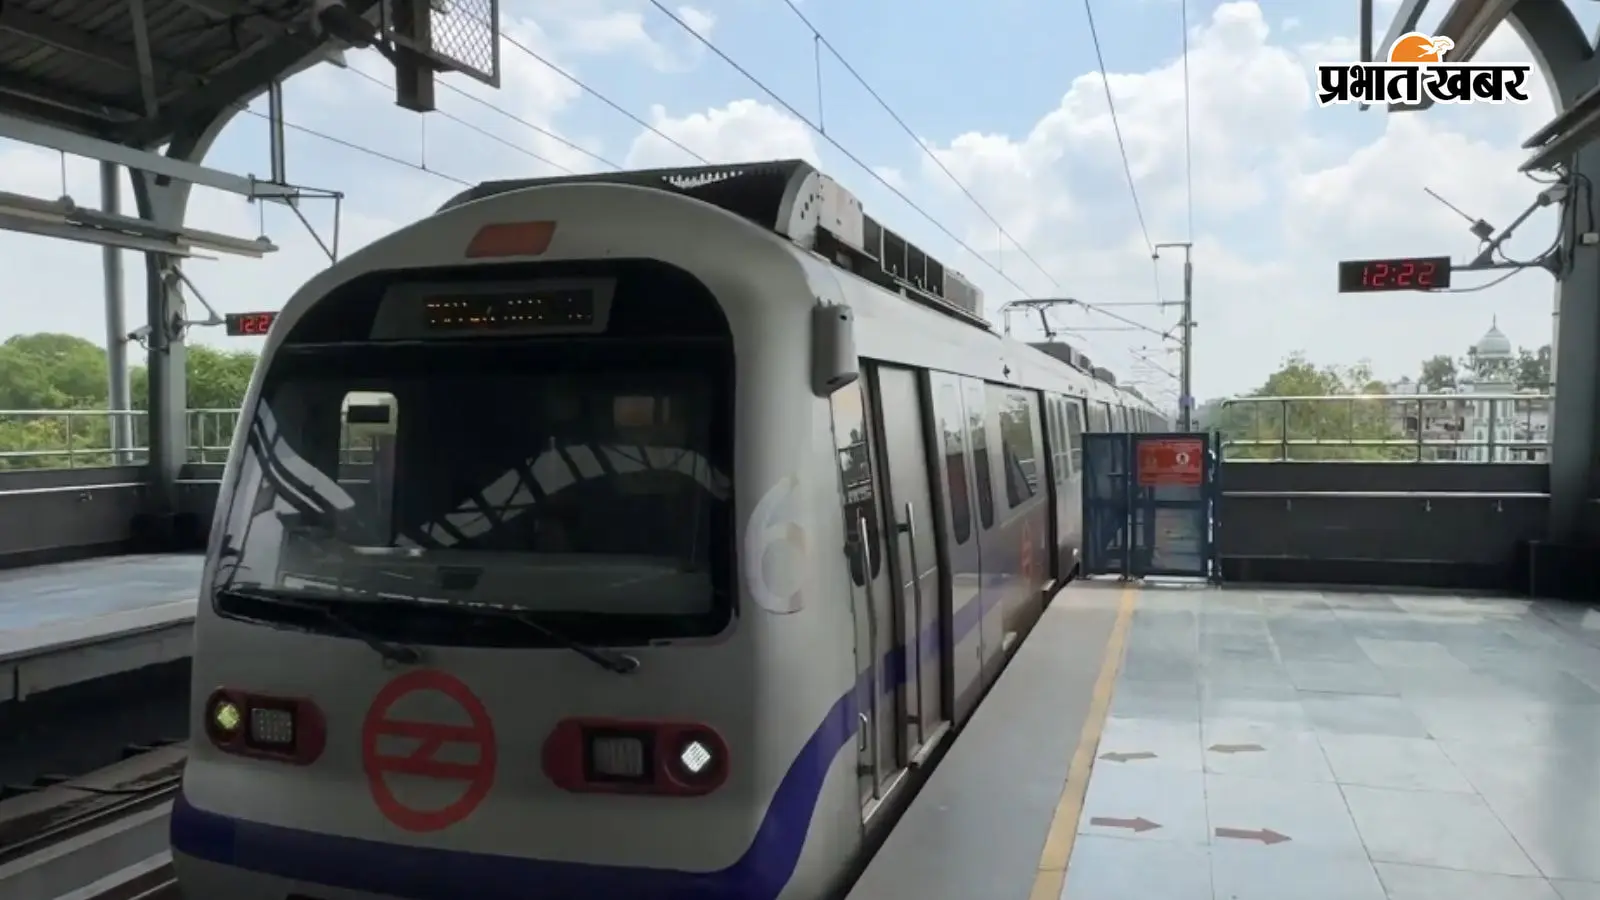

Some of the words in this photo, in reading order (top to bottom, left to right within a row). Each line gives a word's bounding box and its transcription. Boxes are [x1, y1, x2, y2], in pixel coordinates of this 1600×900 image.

[1362, 262, 1436, 287] 12:22
[240, 315, 269, 333] 12:2
[744, 473, 808, 615] 6
